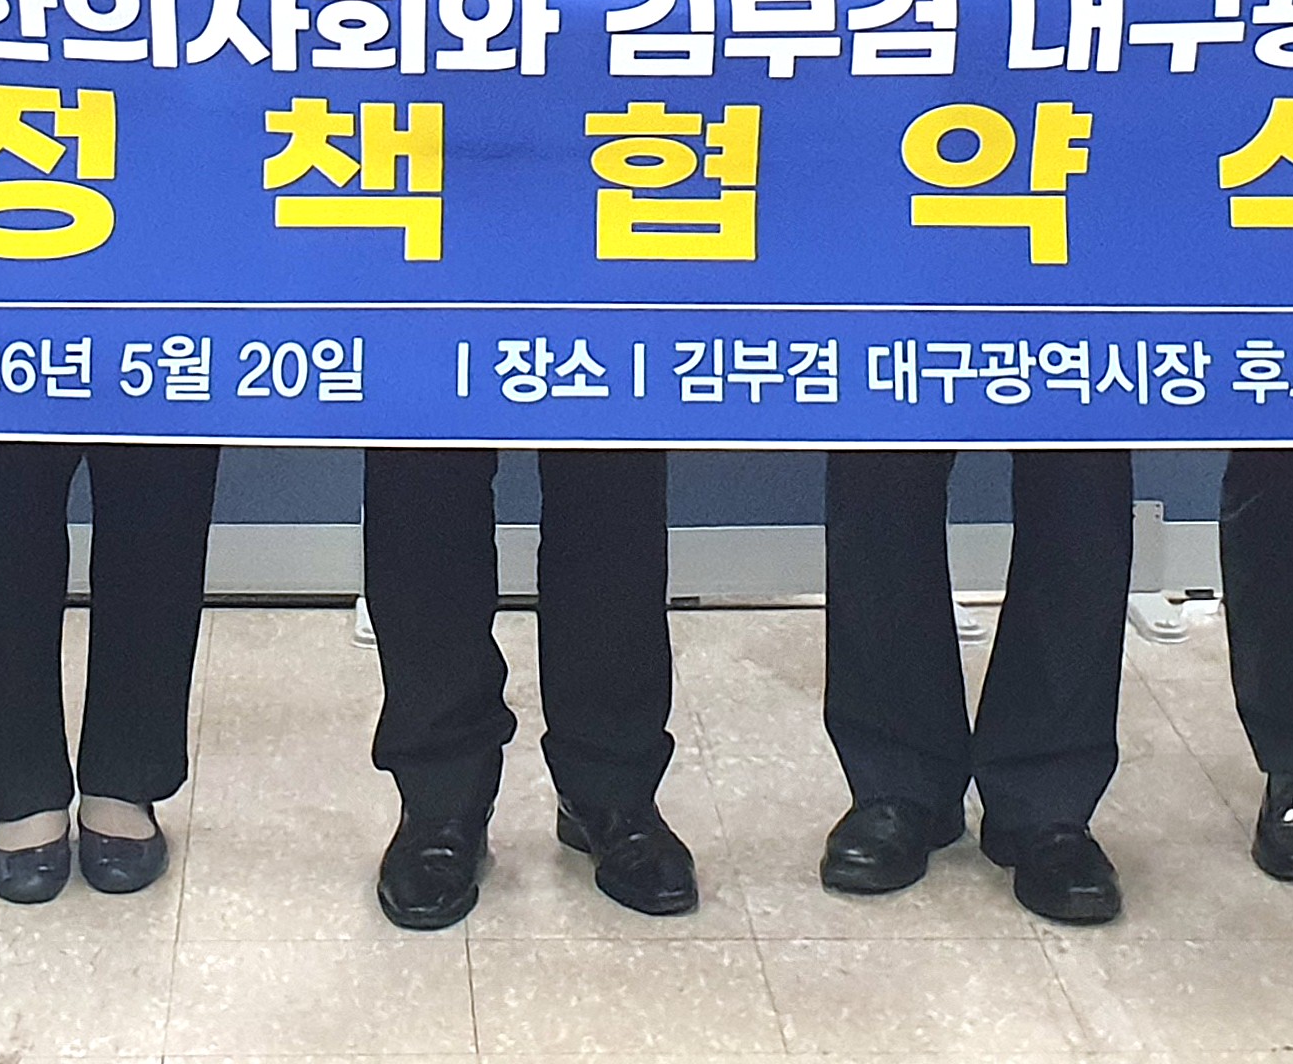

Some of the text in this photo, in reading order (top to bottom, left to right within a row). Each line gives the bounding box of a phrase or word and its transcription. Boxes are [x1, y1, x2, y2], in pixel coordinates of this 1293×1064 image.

[120, 335, 211, 401] 5월
[237, 337, 363, 401] 20일
[494, 337, 609, 403] 장소
[673, 339, 838, 403] 김부겸
[868, 339, 1211, 405] 대구광역시장
